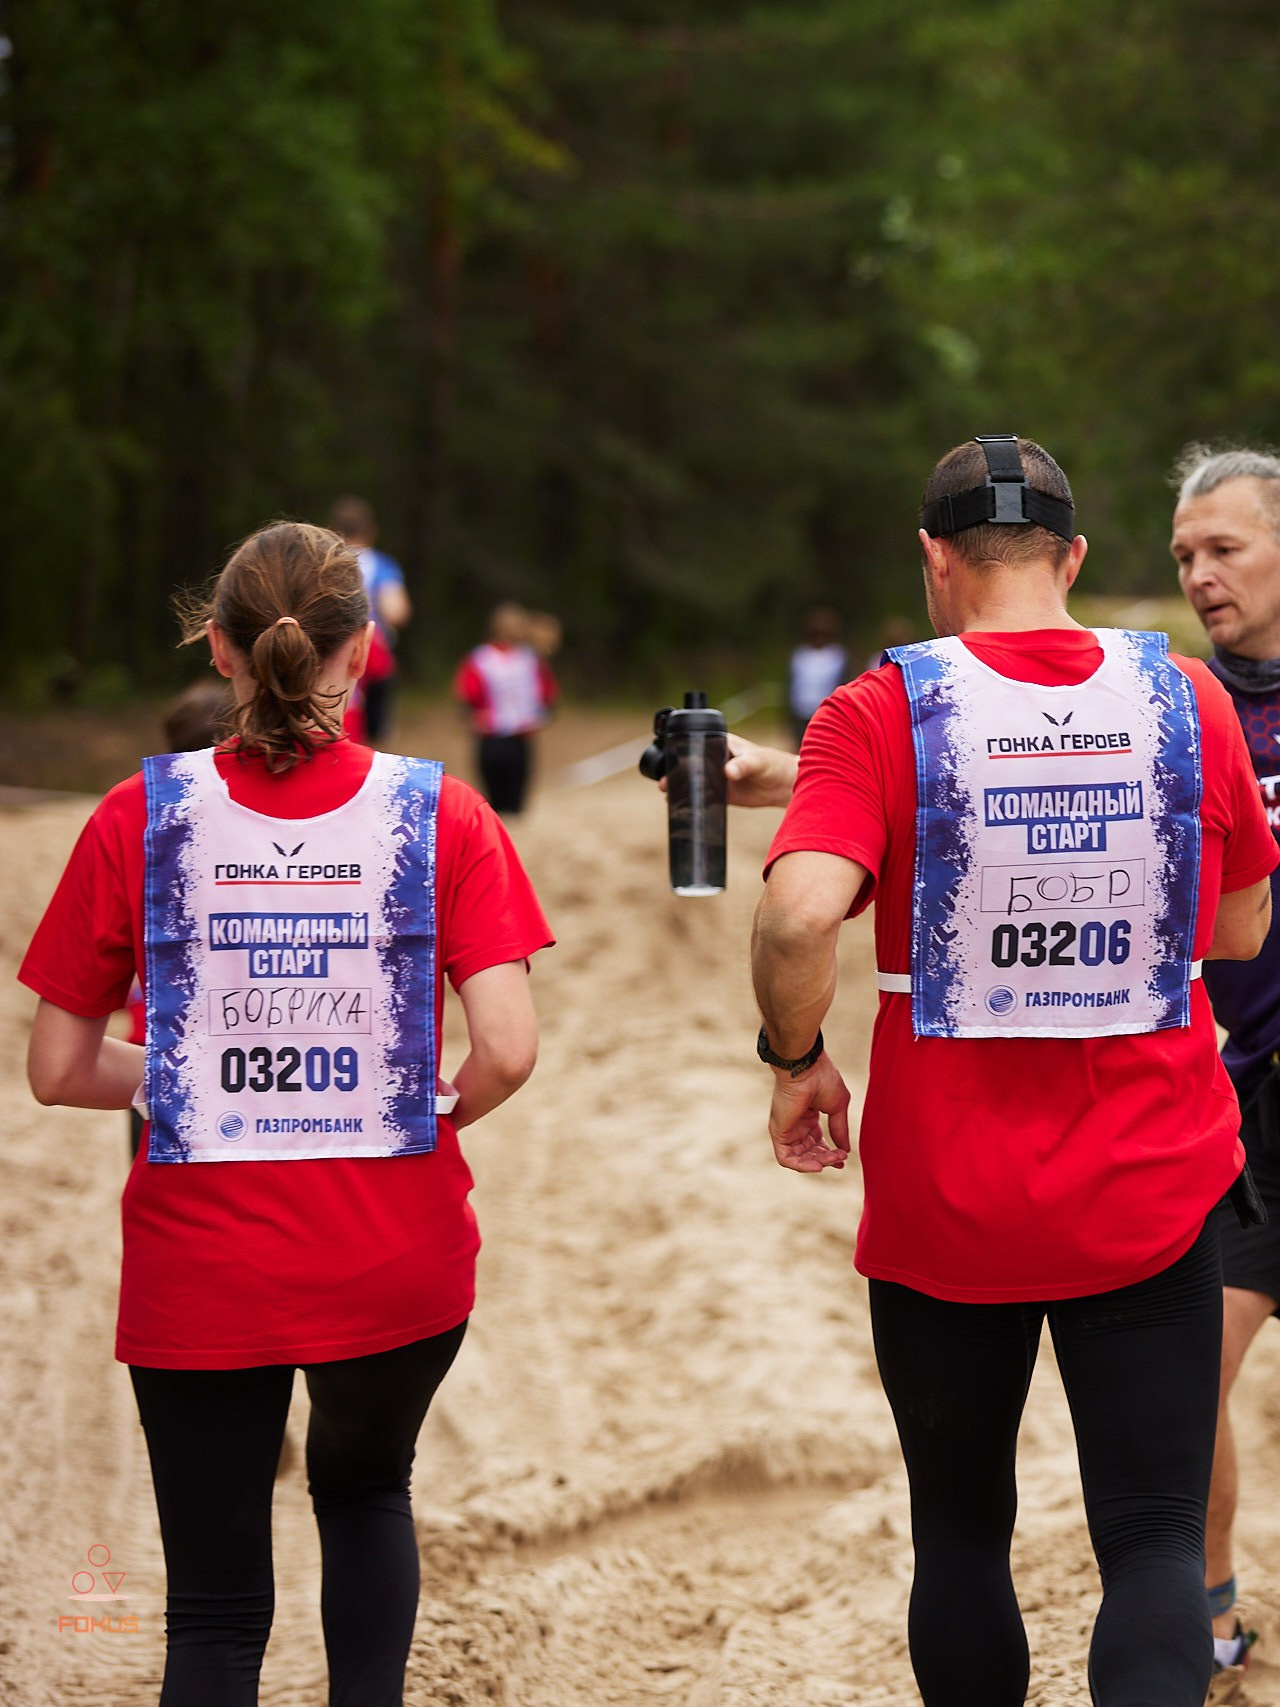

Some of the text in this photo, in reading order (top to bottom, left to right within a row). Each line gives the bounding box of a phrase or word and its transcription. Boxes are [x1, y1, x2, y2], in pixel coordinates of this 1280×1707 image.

[986, 732, 1131, 754] ГОНКА ГЕРОЕВ
[987, 781, 1142, 821] КОМАНДНЫЙ
[1032, 822, 1102, 851] СТАРТ
[214, 864, 361, 879] ГОНКА ГЕРОЕВ
[1007, 869, 1131, 916] БОБР
[211, 912, 367, 948] КОМАНДНЫЙ
[990, 919, 1131, 968] 03206
[252, 949, 324, 975] СТАРТ
[221, 987, 368, 1030] БОБРИХА
[1025, 988, 1130, 1008] ГАЗПРОМБАНК
[220, 1046, 359, 1093] 03209
[255, 1118, 363, 1134] ГАЗПРОМБАНК
